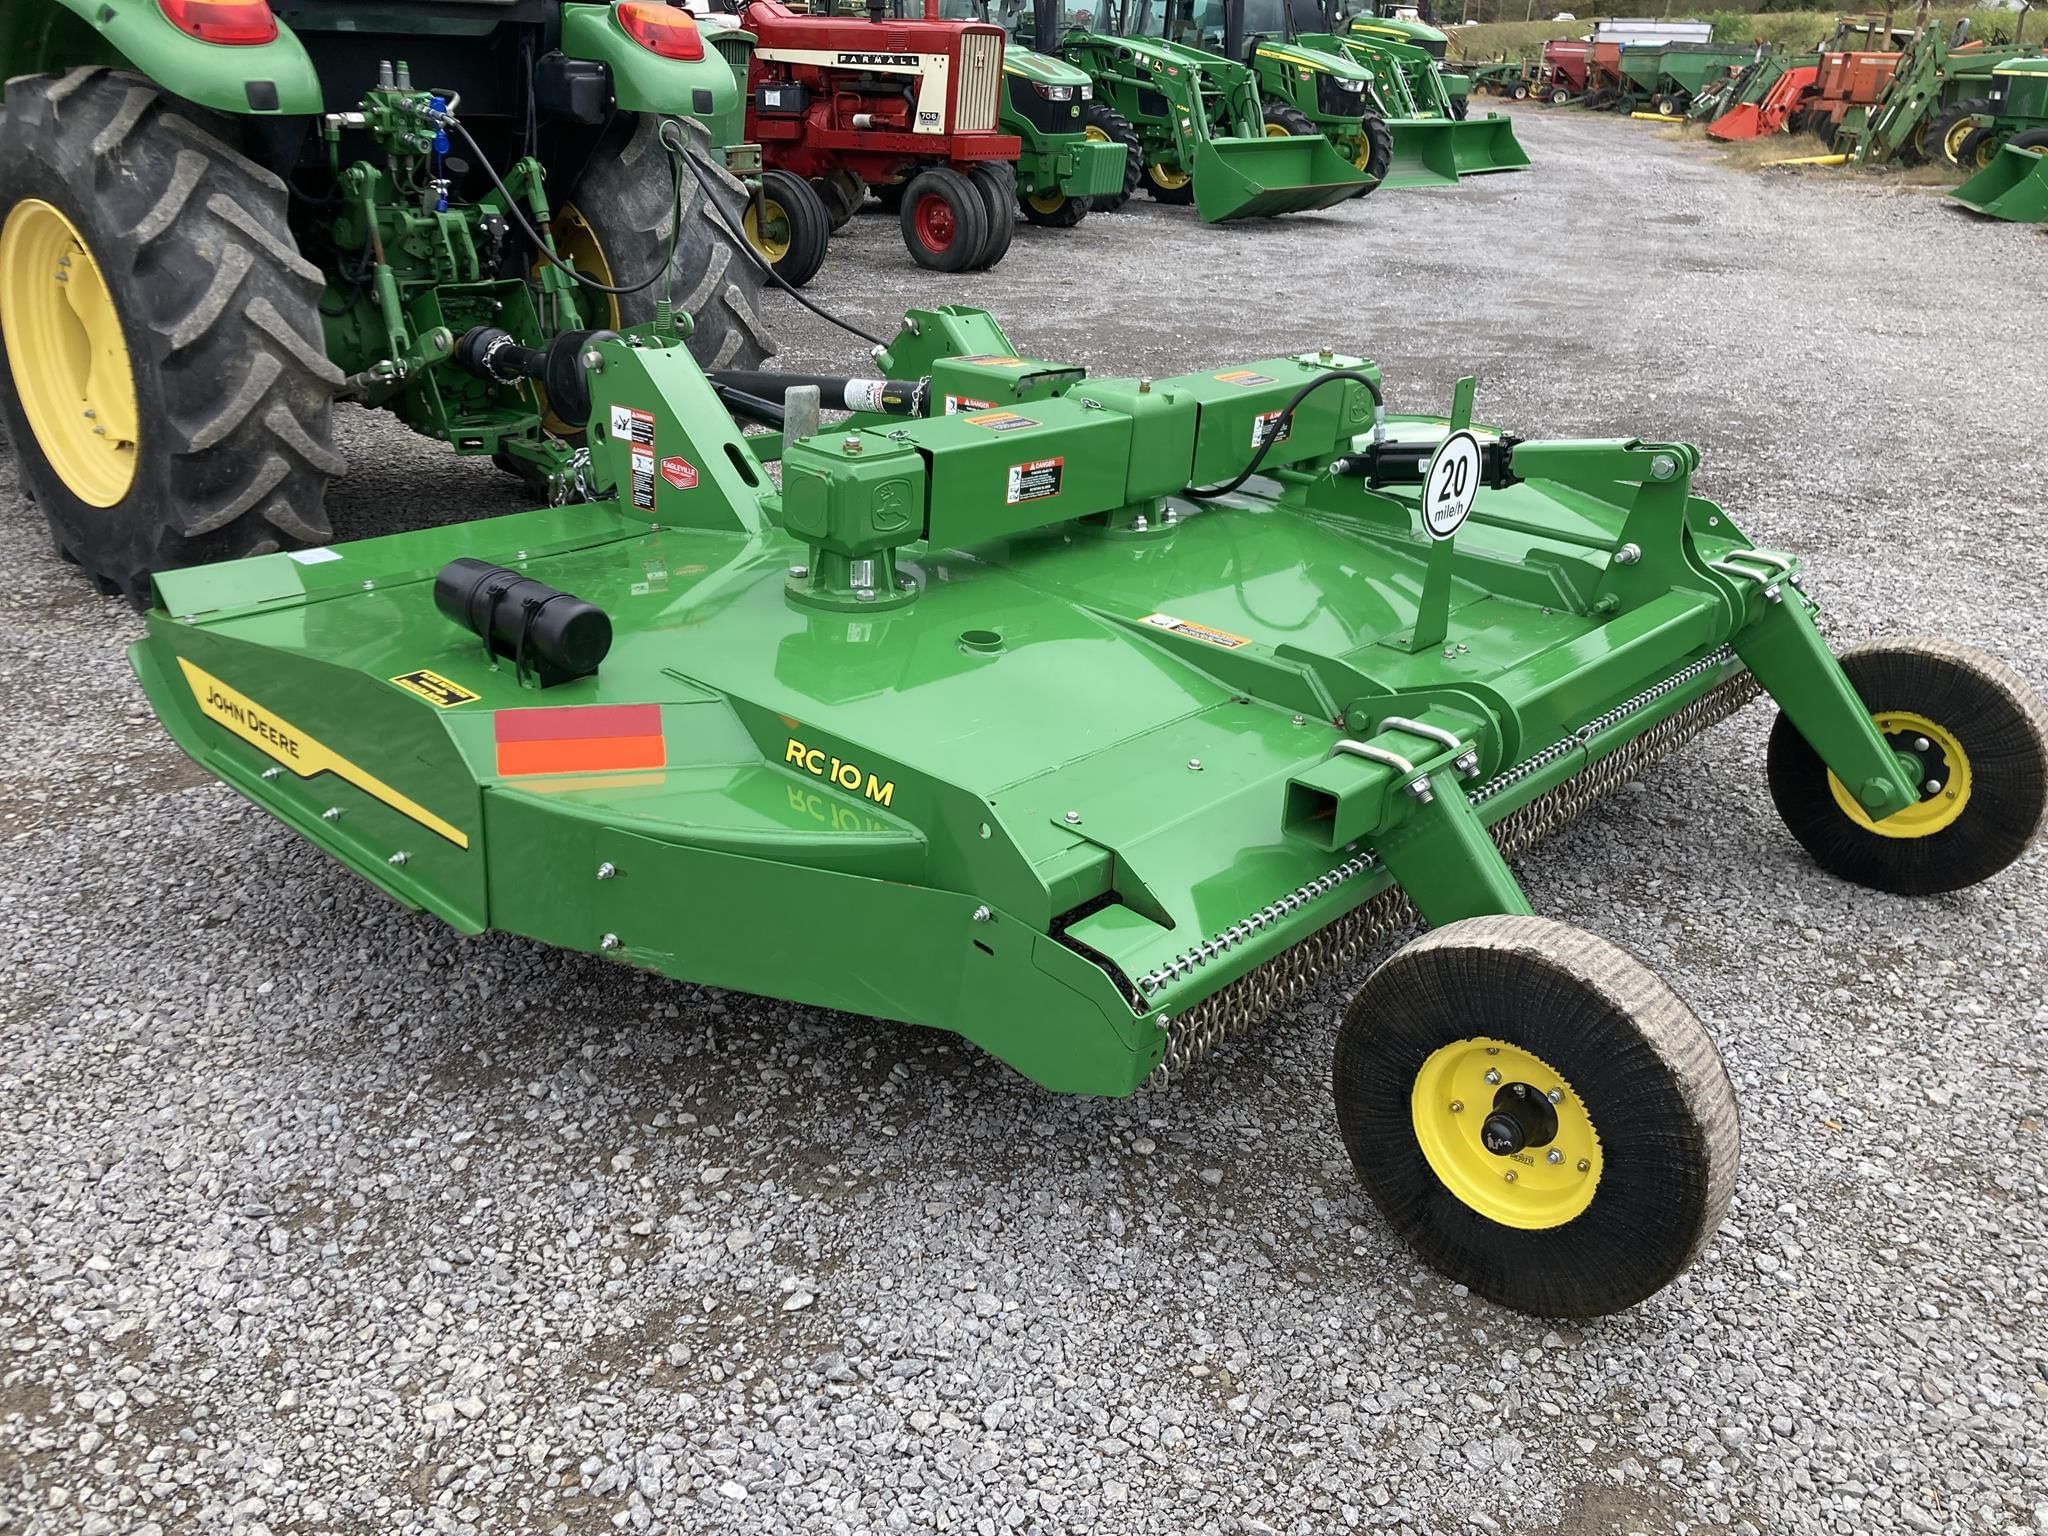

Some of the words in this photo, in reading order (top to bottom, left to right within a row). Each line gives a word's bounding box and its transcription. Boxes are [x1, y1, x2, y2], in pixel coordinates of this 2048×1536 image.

[840, 55, 918, 65] FARMALL
[921, 112, 937, 120] 706
[663, 461, 696, 475] EAGLEVILLE
[1036, 460, 1055, 469] DANGER
[1438, 455, 1468, 502] 20
[1434, 501, 1464, 523] mile/h
[206, 686, 245, 724] JOHN
[247, 709, 300, 759] DEERE
[785, 738, 826, 775] RC
[829, 756, 862, 790] 10
[864, 772, 895, 807] M
